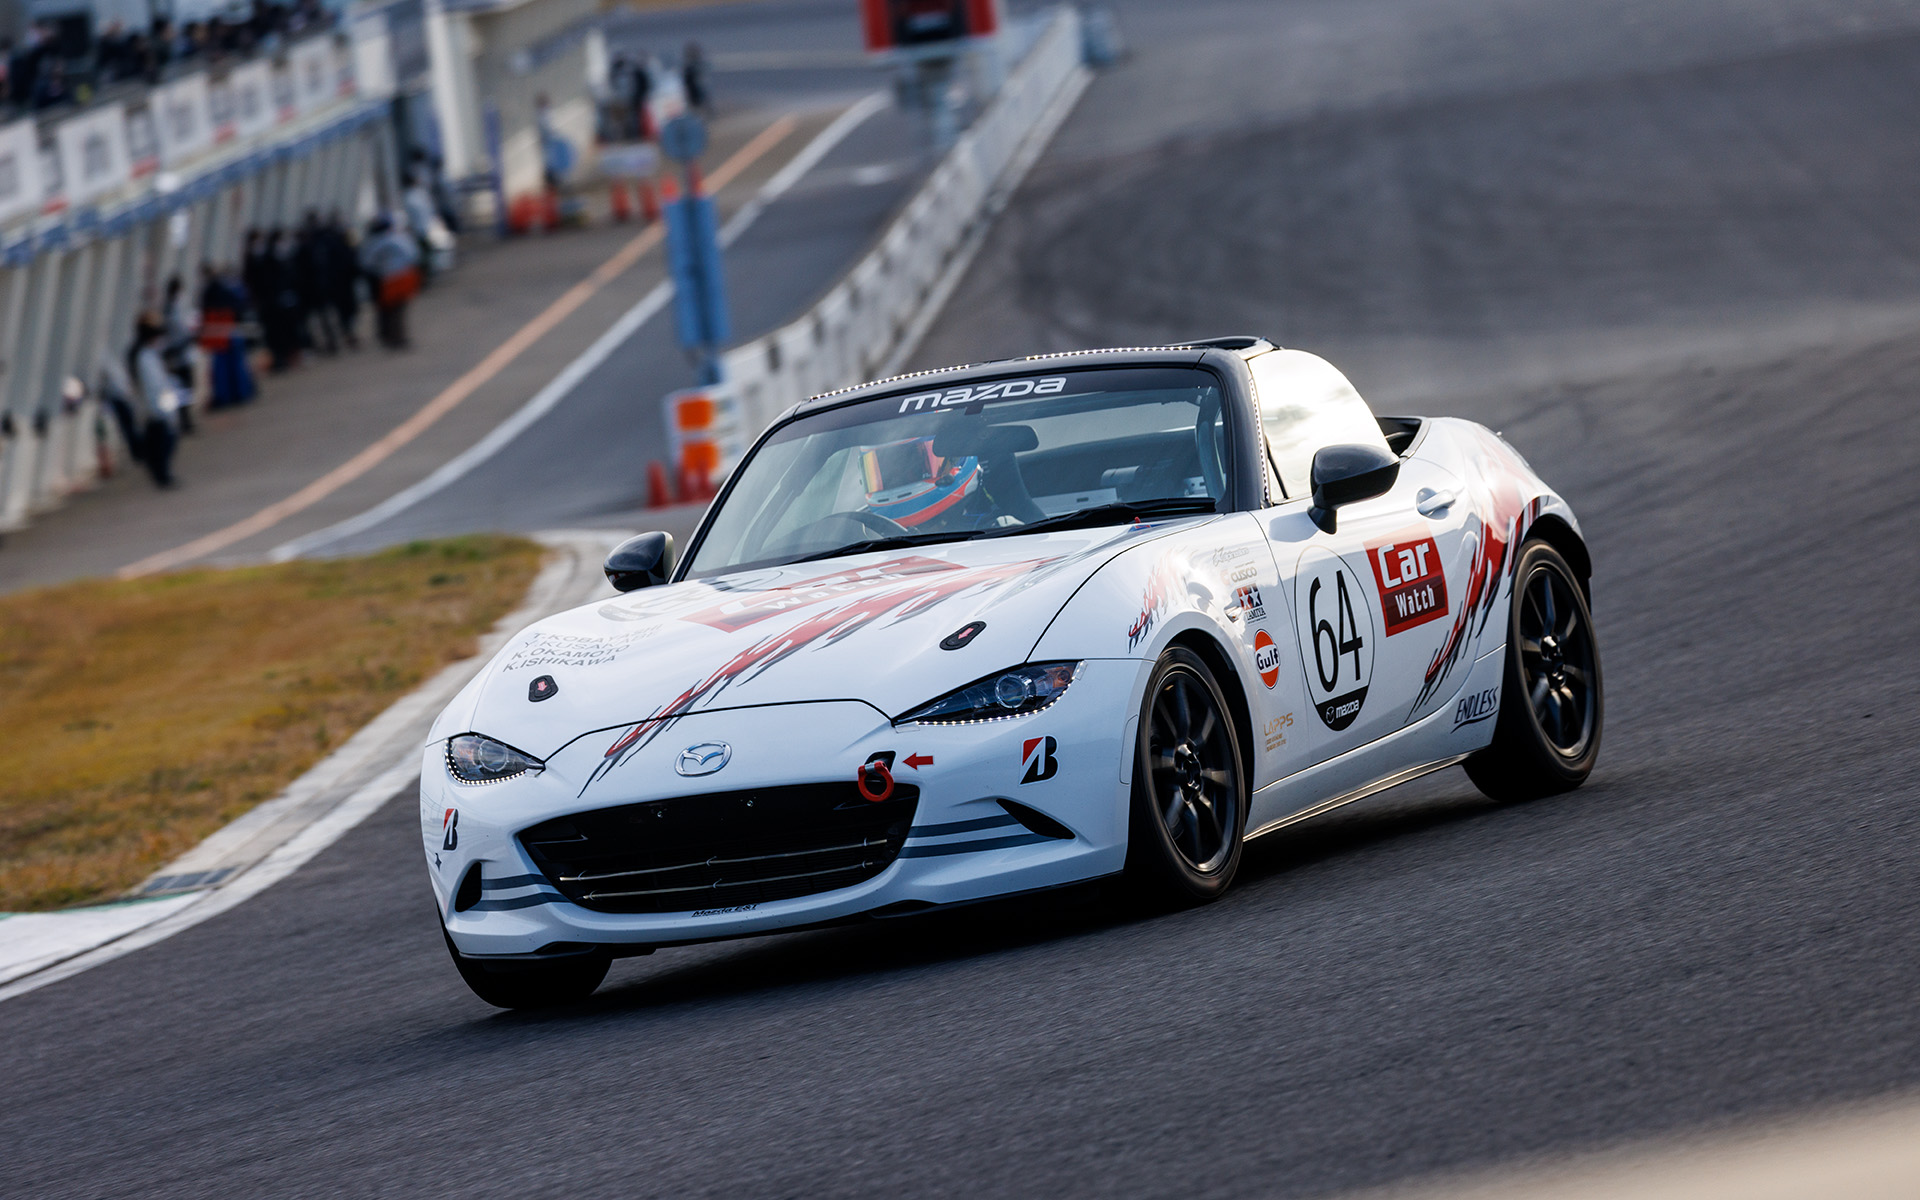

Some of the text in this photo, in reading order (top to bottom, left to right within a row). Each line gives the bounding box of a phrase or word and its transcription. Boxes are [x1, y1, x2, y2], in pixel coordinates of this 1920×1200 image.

[898, 377, 1067, 413] mazda
[1377, 542, 1430, 589] Car
[1244, 606, 1267, 621] TAMIYA
[1394, 584, 1436, 618] Watch
[1309, 569, 1364, 692] 64
[502, 655, 616, 673] K.ISHIKAWA
[511, 644, 631, 661] K.OKAMOTO
[1256, 647, 1279, 671] Gulf
[1335, 700, 1360, 719] mazda
[1453, 686, 1499, 724] ENDLESS
